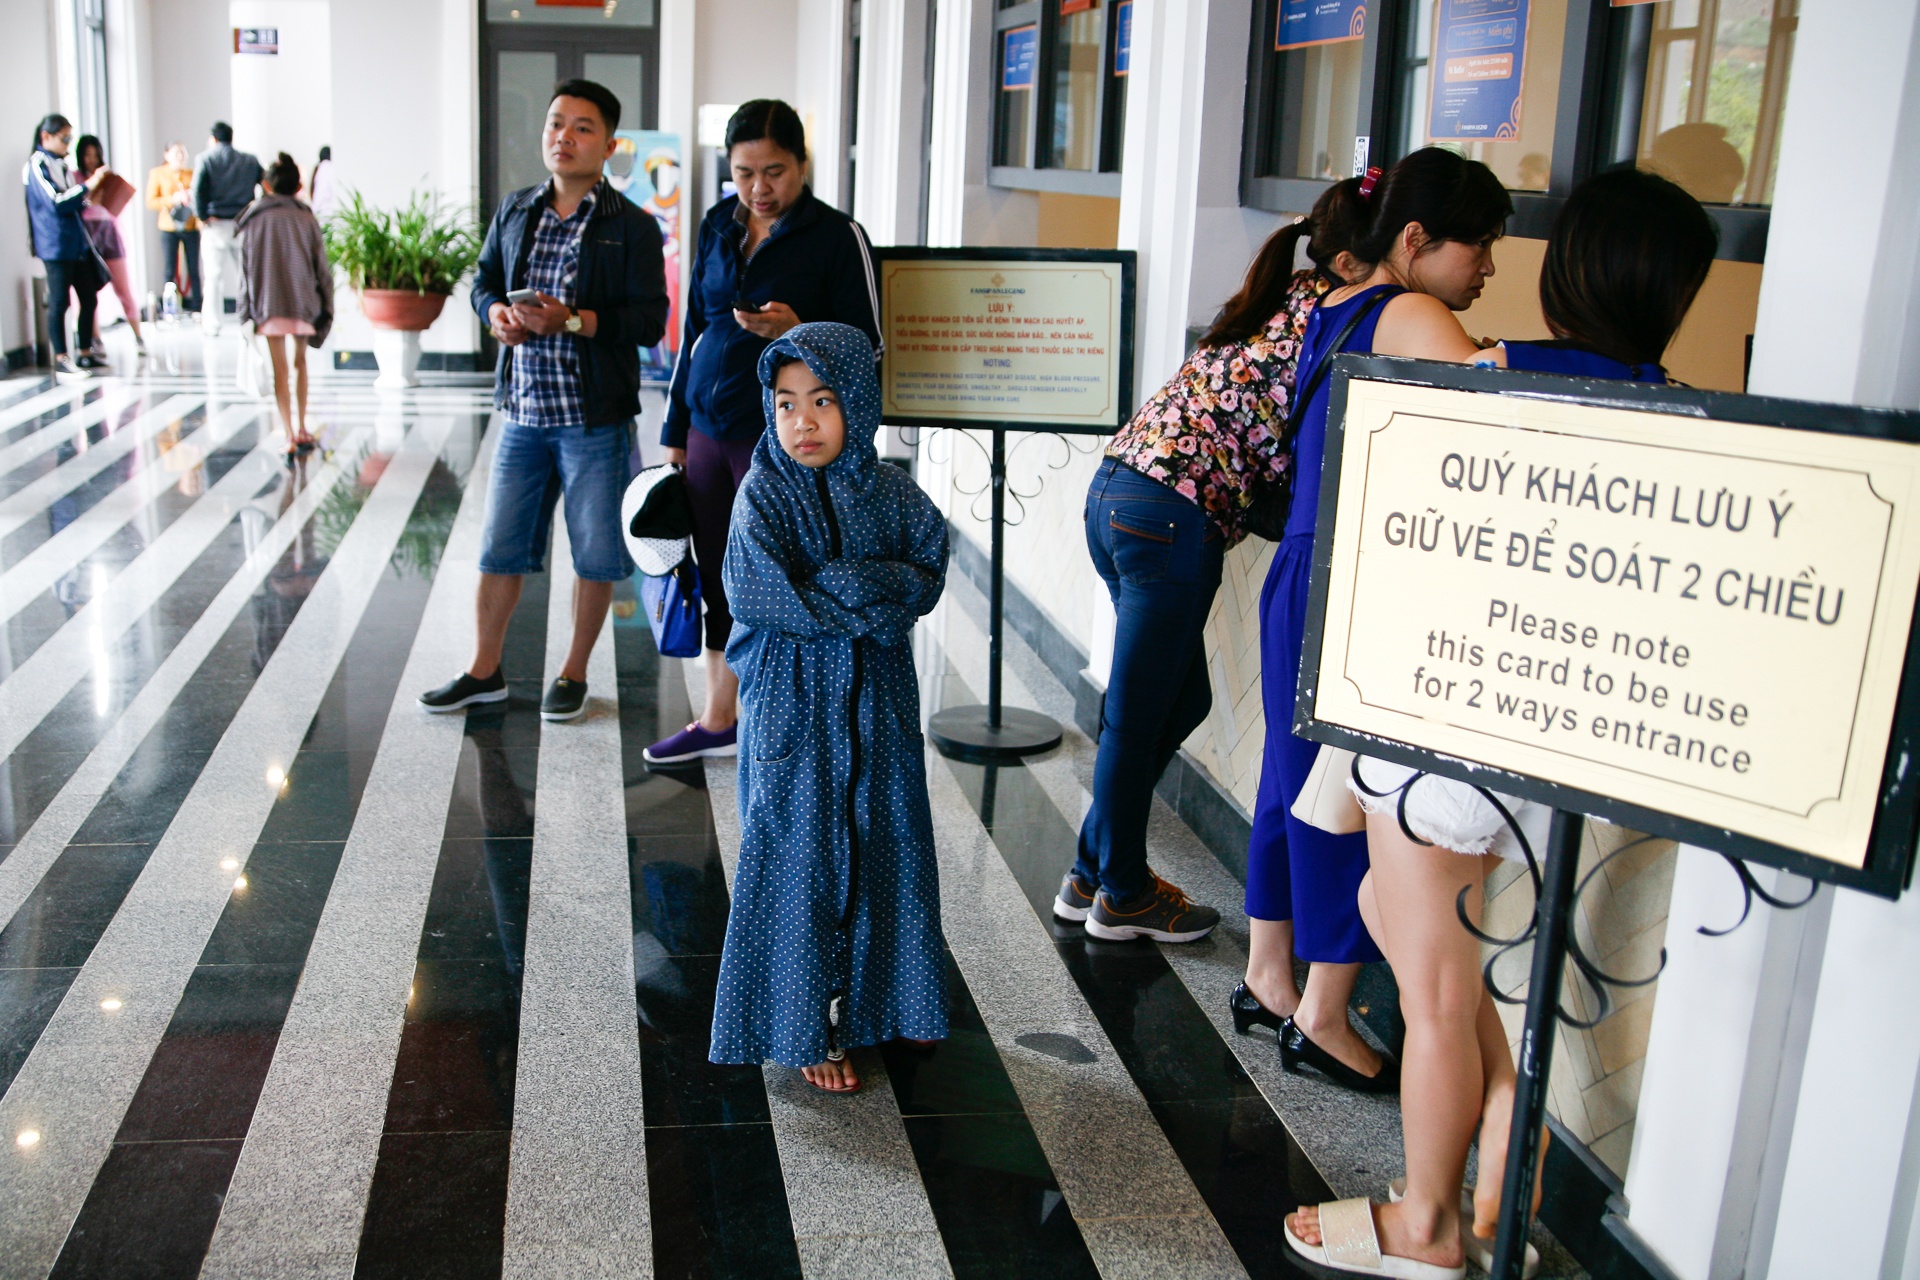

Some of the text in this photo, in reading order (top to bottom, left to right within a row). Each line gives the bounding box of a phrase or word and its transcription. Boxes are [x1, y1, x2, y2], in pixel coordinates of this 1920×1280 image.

[1440, 451, 1794, 538] QUÝ KHÁCH LƯU Ý
[1384, 507, 1844, 626] GIỮ VÉ ĐỂ SOÁT 2 CHIỀU
[1426, 630, 1750, 726] this card to be use
[1487, 599, 1691, 668] Please note
[1414, 667, 1752, 774] for 2 ways entrance
